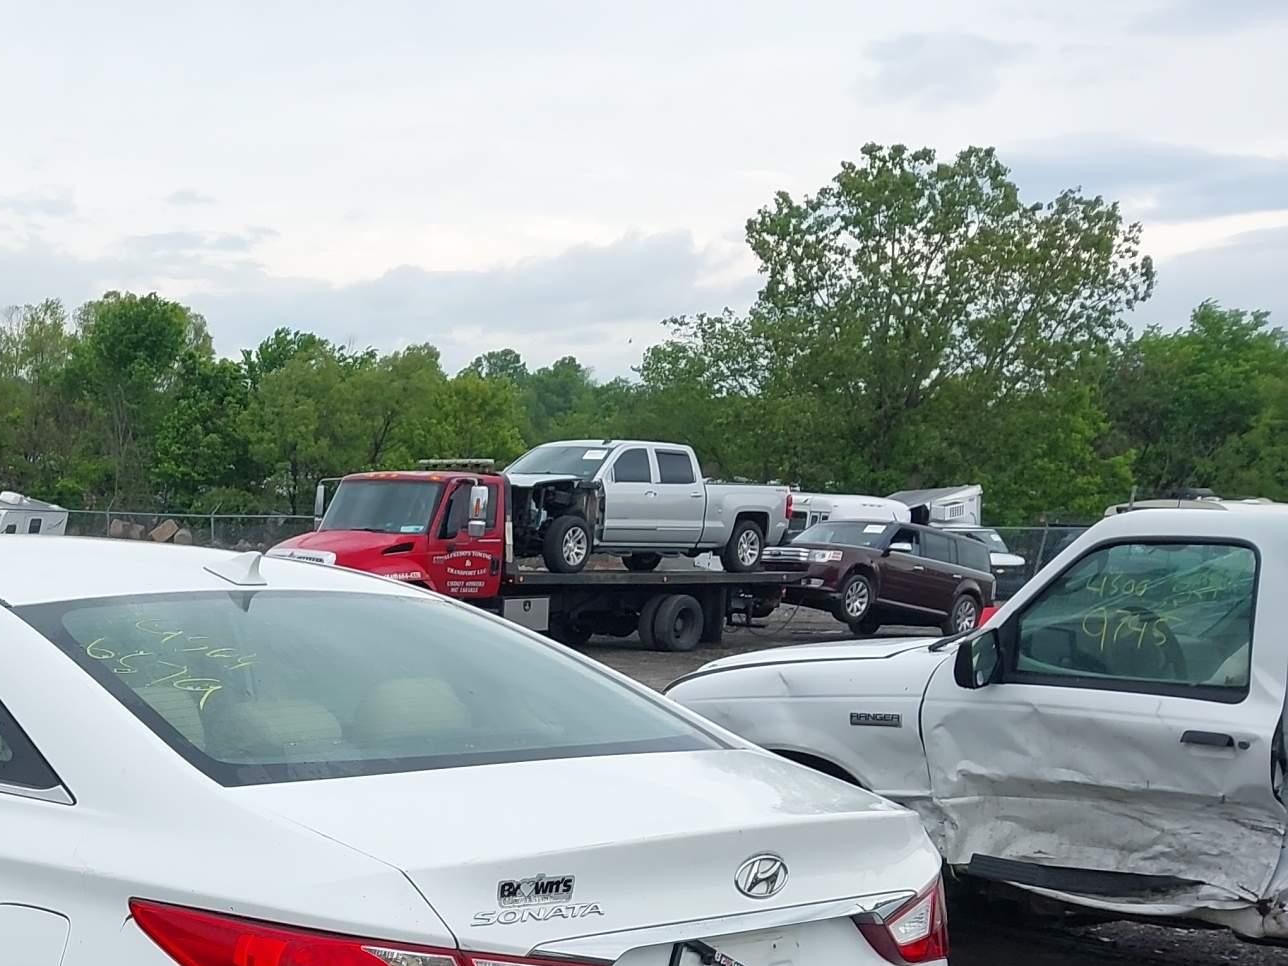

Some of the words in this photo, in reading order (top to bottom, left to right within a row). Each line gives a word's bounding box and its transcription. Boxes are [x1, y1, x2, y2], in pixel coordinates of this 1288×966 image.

[87, 637, 223, 711] 6579
[850, 712, 900, 721] RANGER
[470, 902, 605, 927] SONATA
